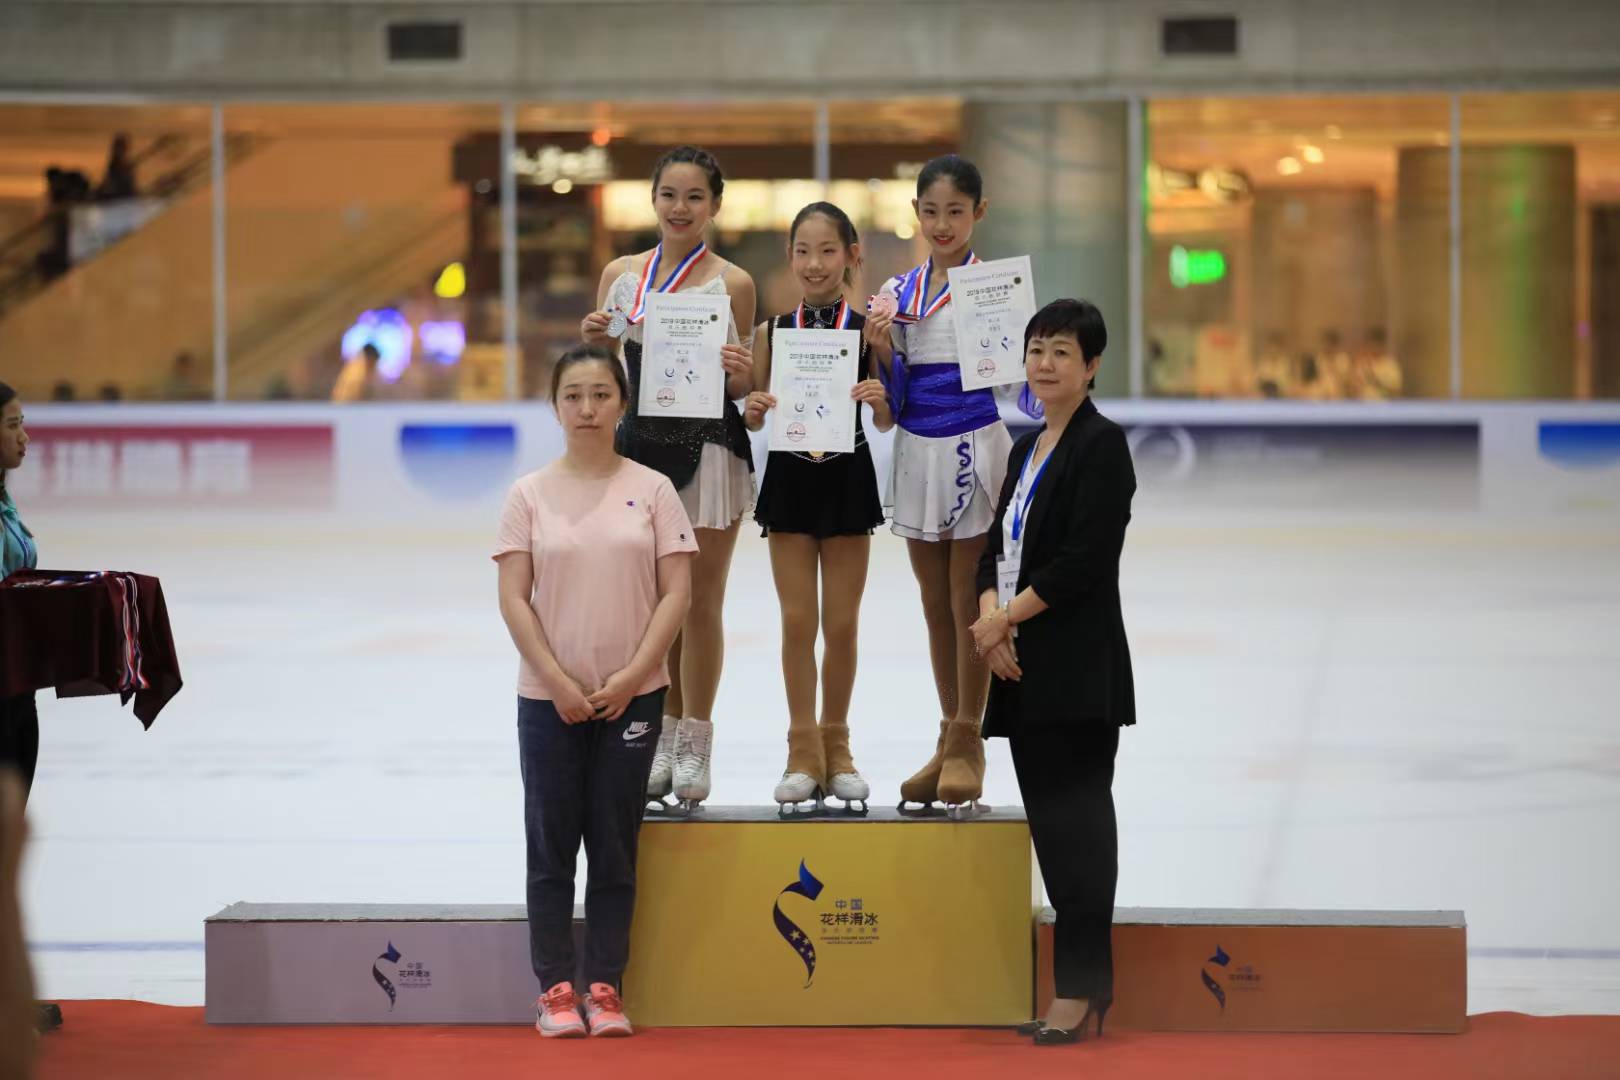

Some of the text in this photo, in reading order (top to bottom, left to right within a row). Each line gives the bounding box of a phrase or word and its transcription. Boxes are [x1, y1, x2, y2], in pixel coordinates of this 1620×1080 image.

[628, 721, 649, 732] NIKE
[835, 899, 863, 910] 中国
[820, 912, 879, 926] 花样滑冰
